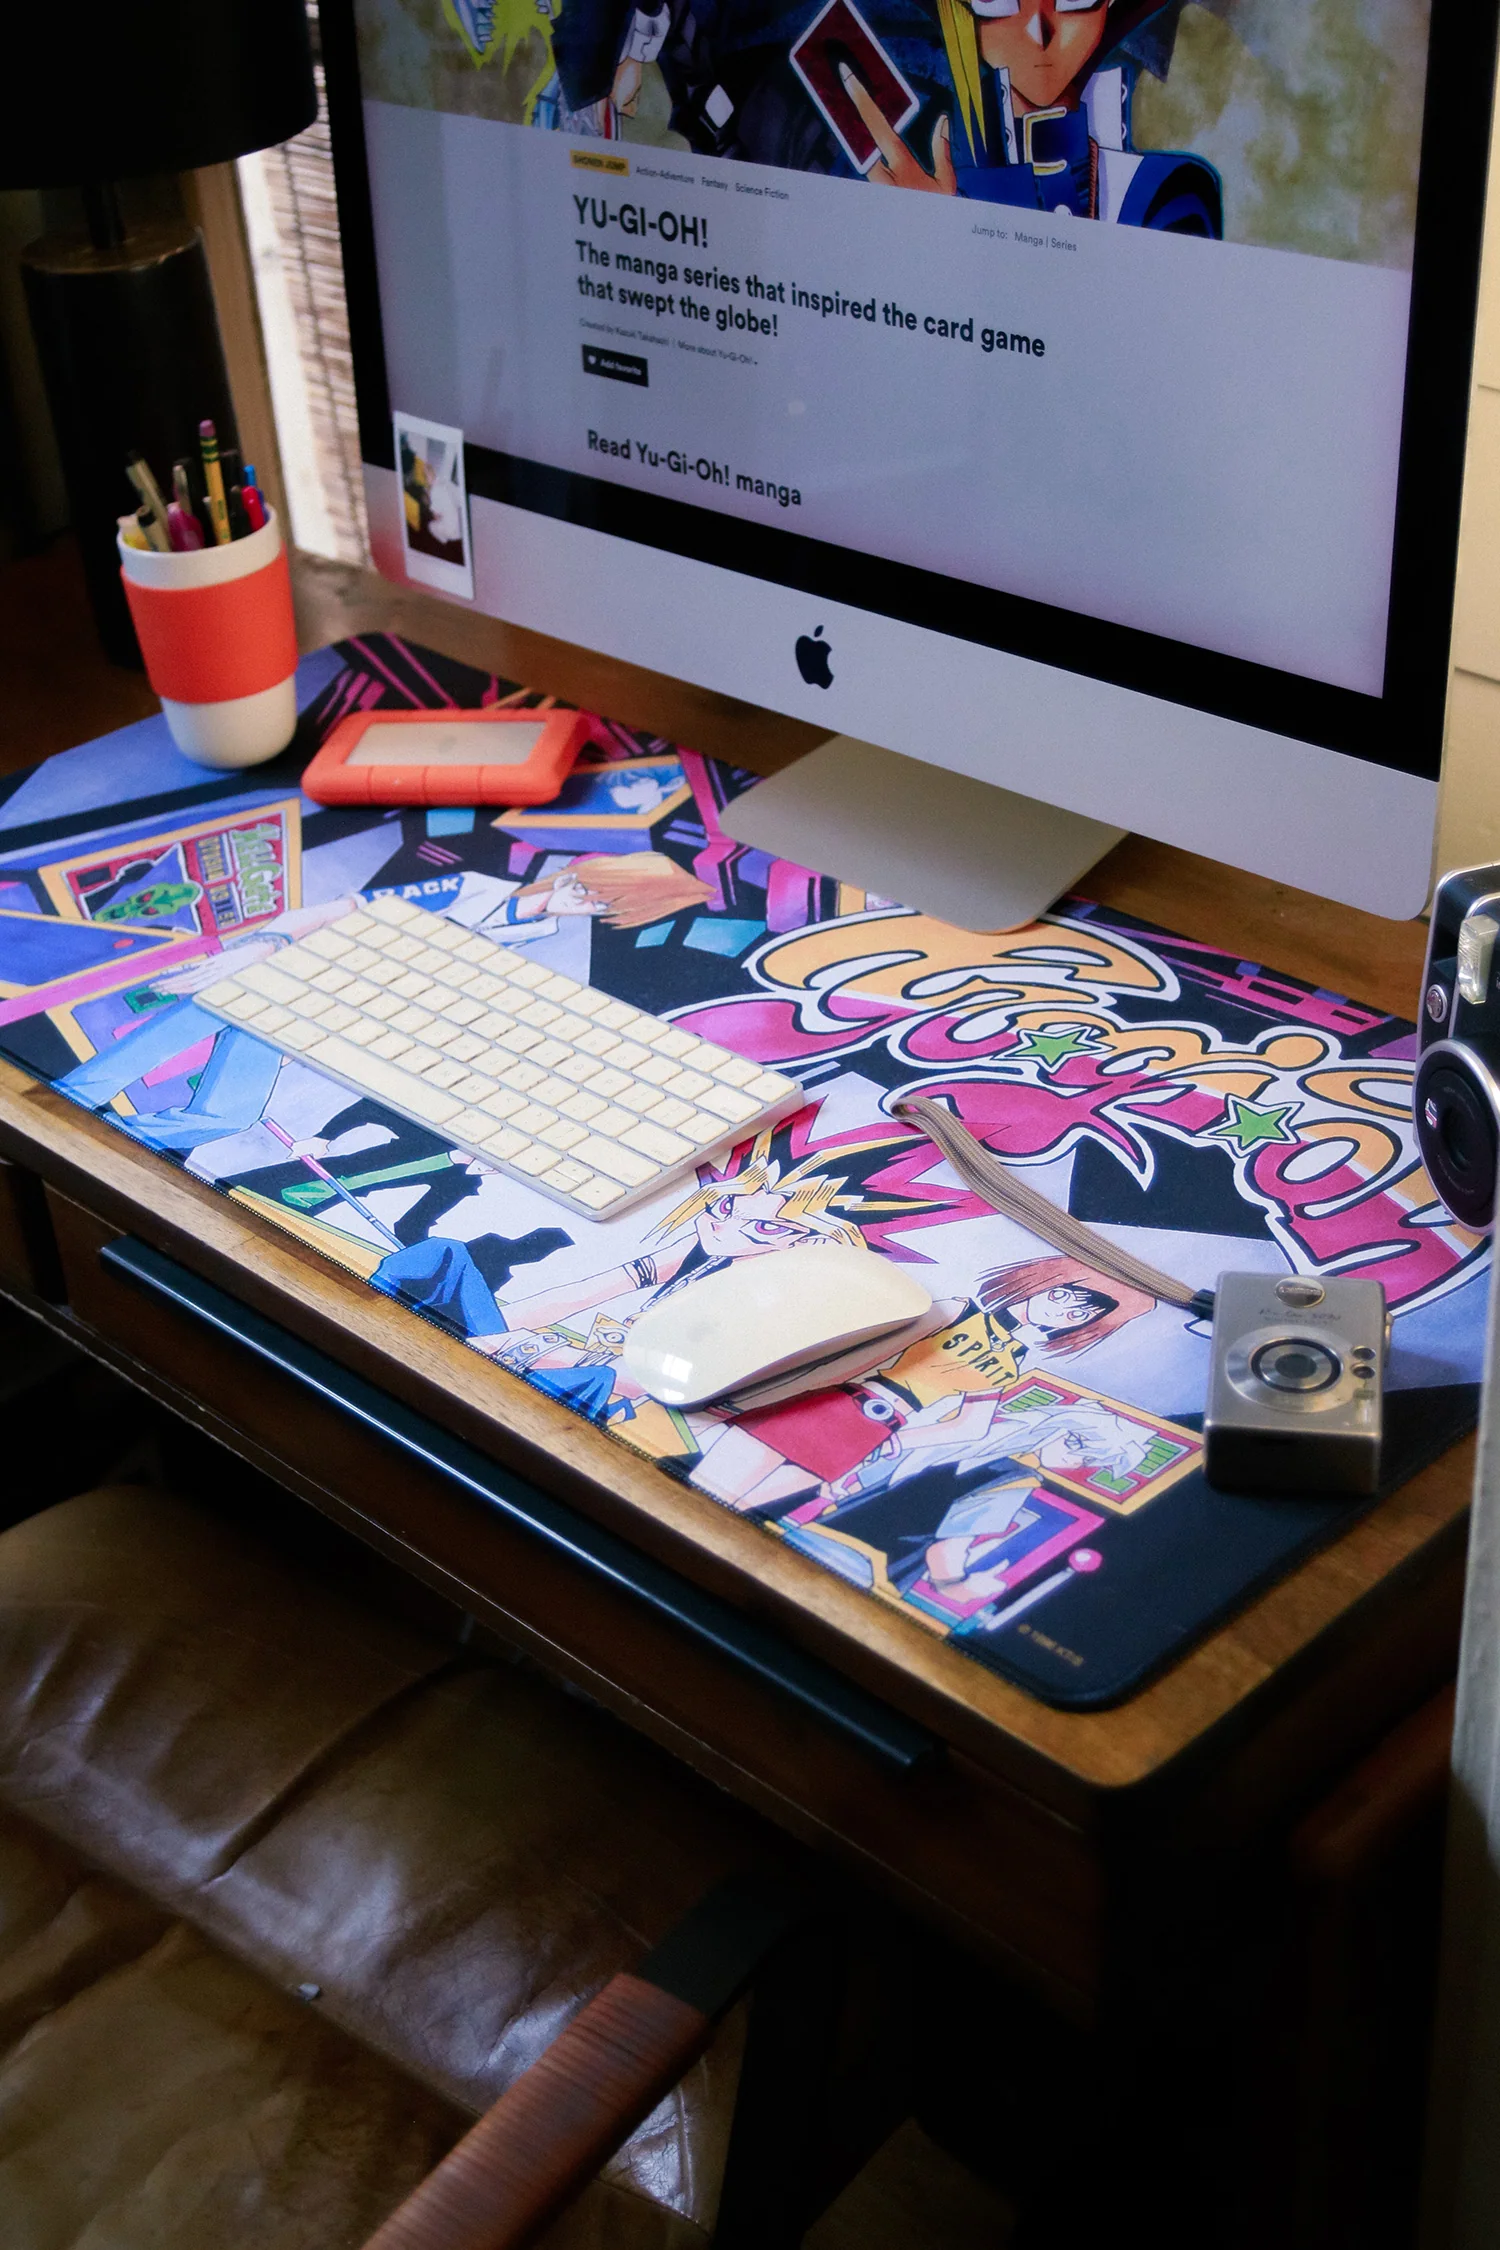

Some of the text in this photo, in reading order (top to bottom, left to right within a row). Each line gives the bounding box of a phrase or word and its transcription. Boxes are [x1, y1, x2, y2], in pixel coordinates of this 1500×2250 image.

[636, 165, 789, 200] Action-Adventure Fantasy Science Fiction
[573, 194, 709, 248] YU-GI-OH!
[971, 224, 1077, 252] Jump to: Manga Series
[575, 239, 1045, 357] The manga series that inspired the card game
[577, 275, 778, 337] that swept the globe!
[587, 429, 802, 508] Read Yu-Gi-Oh! manga
[941, 1332, 1015, 1387] SPIRIT
